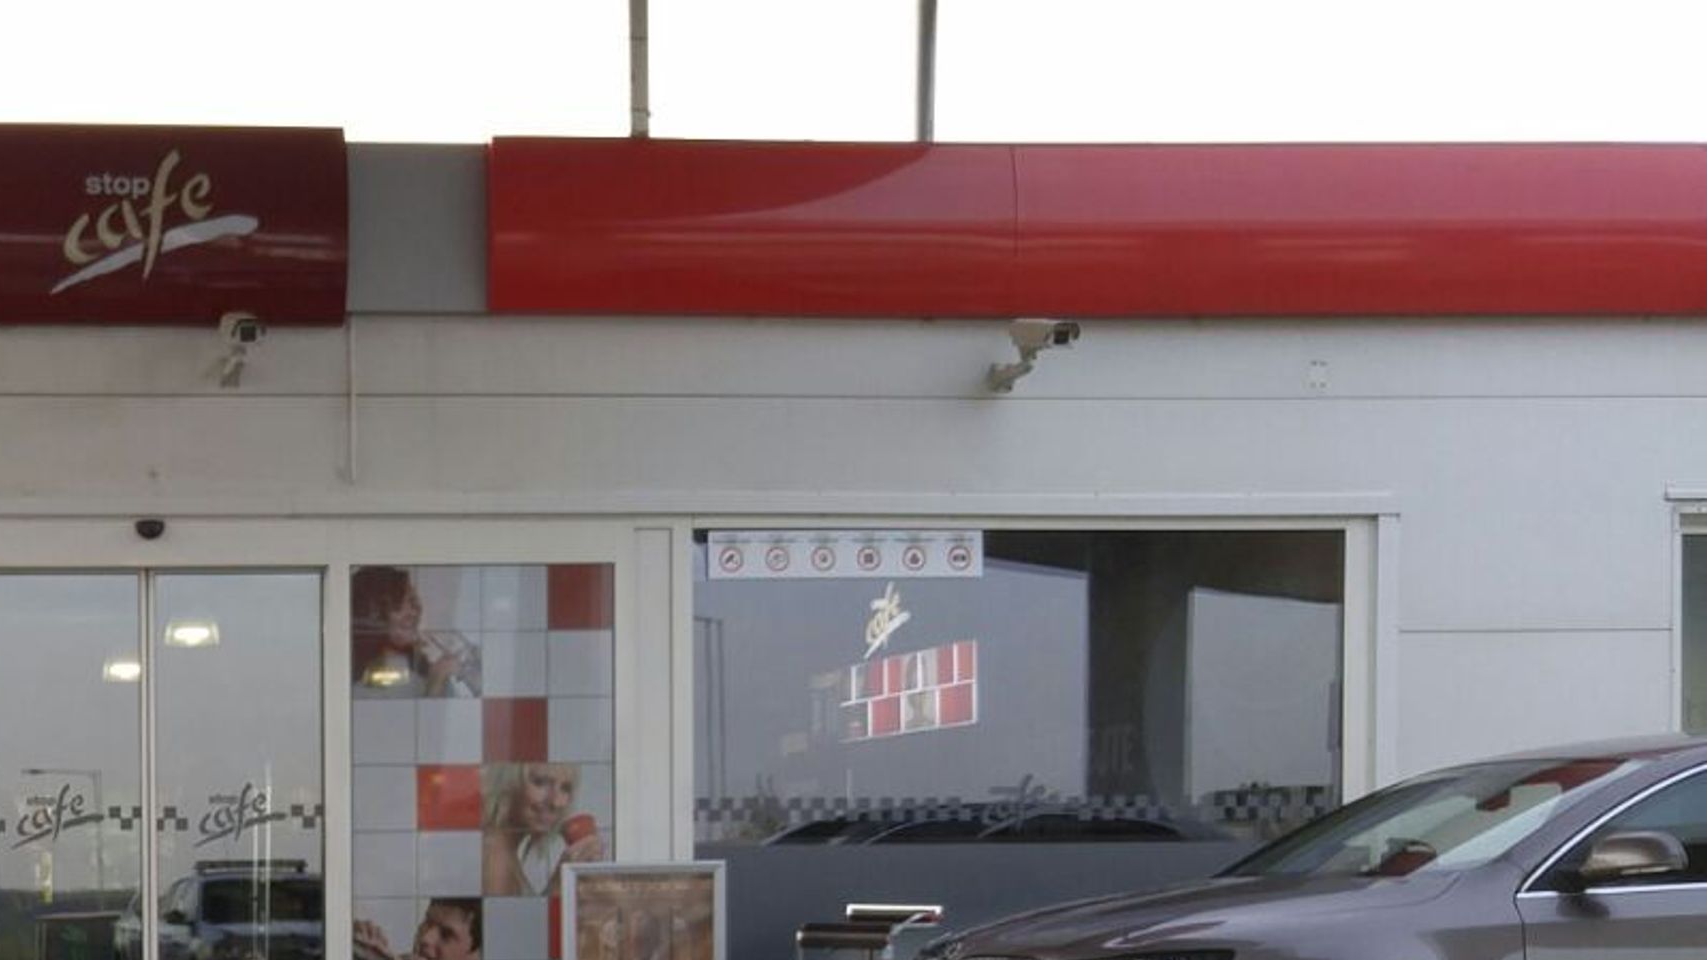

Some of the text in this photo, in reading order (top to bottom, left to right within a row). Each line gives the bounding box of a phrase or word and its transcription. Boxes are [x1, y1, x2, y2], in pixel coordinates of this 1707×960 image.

[62, 149, 216, 280] cafe
[85, 171, 151, 199] stop
[15, 783, 86, 843] cafe
[197, 782, 269, 844] cafe
